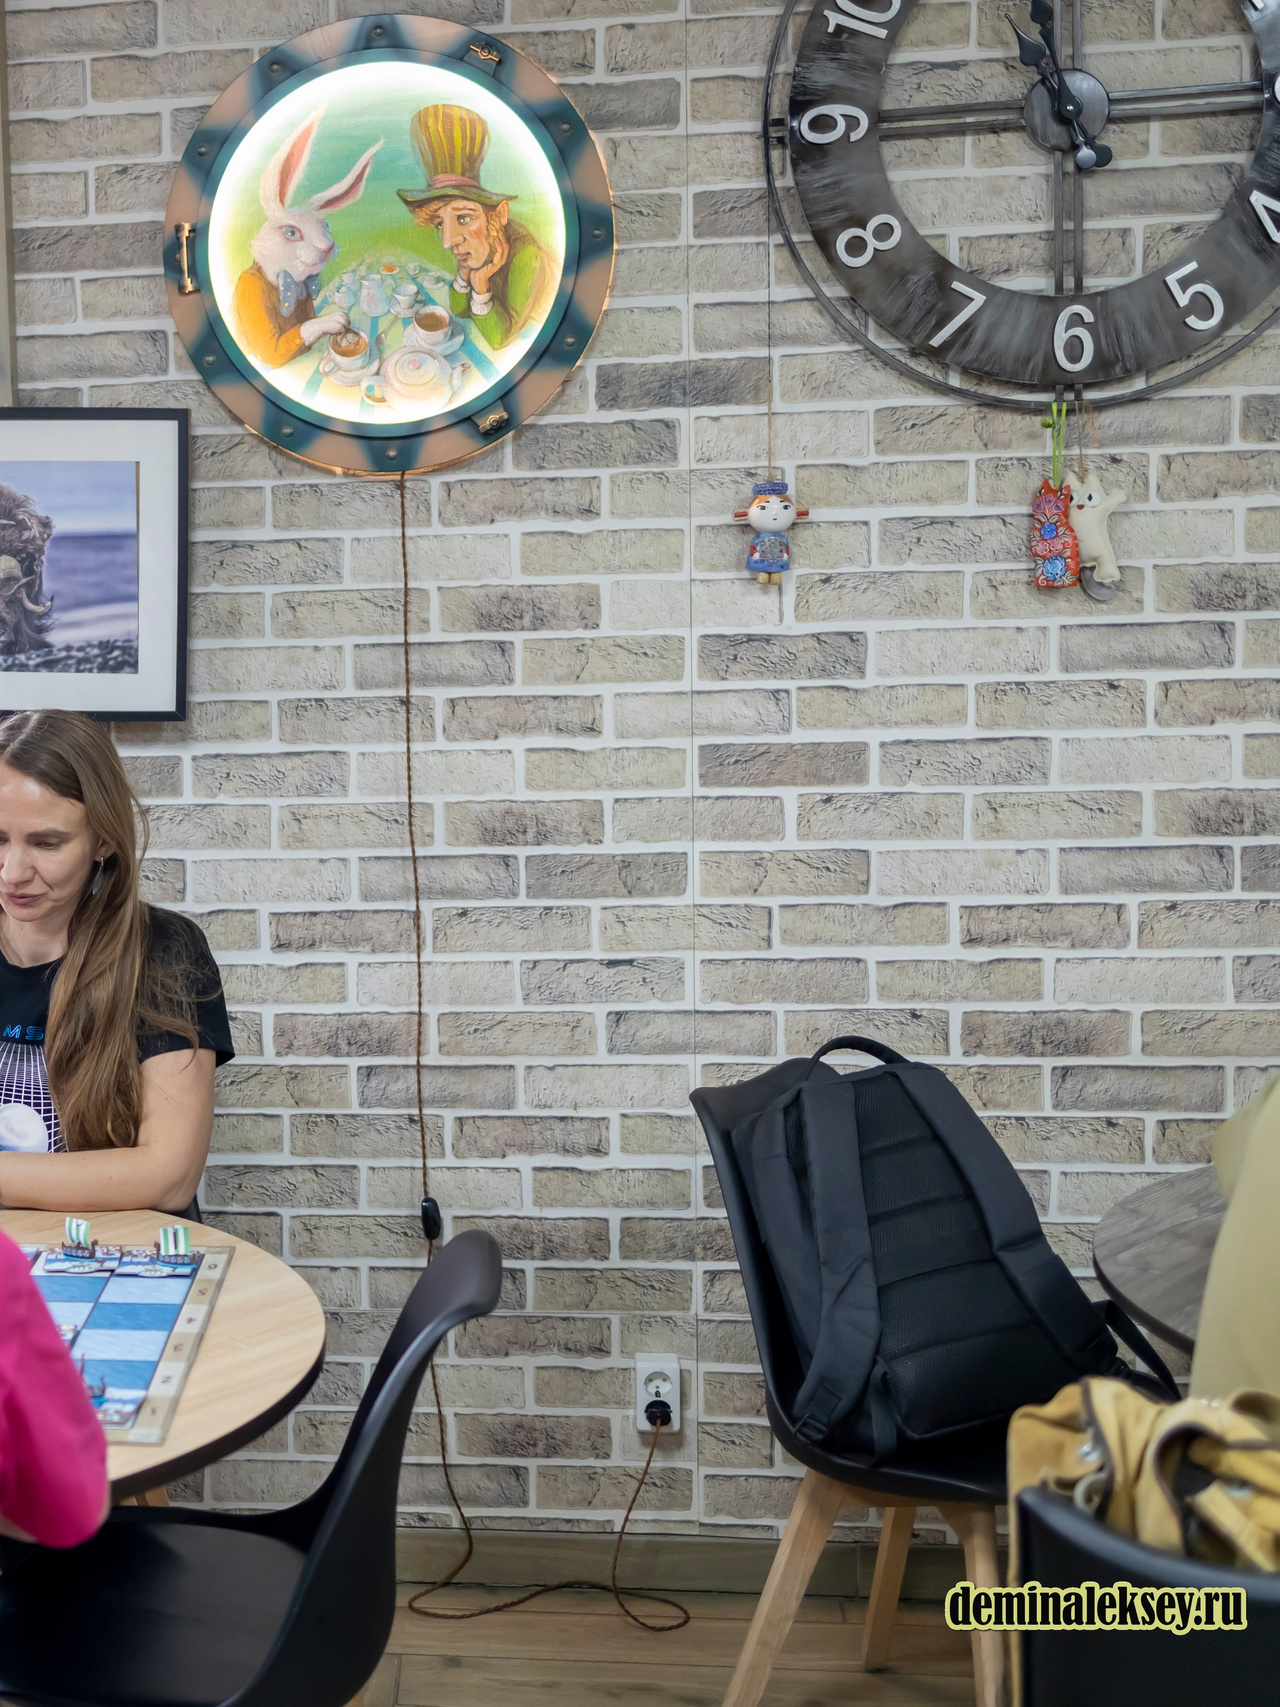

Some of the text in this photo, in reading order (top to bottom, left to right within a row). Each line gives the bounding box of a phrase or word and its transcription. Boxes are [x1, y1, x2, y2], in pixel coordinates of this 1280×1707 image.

[799, 103, 869, 145] 9
[835, 213, 902, 269] 8
[928, 280, 987, 348] 7
[1164, 260, 1225, 331] 5
[1052, 304, 1095, 373] 6
